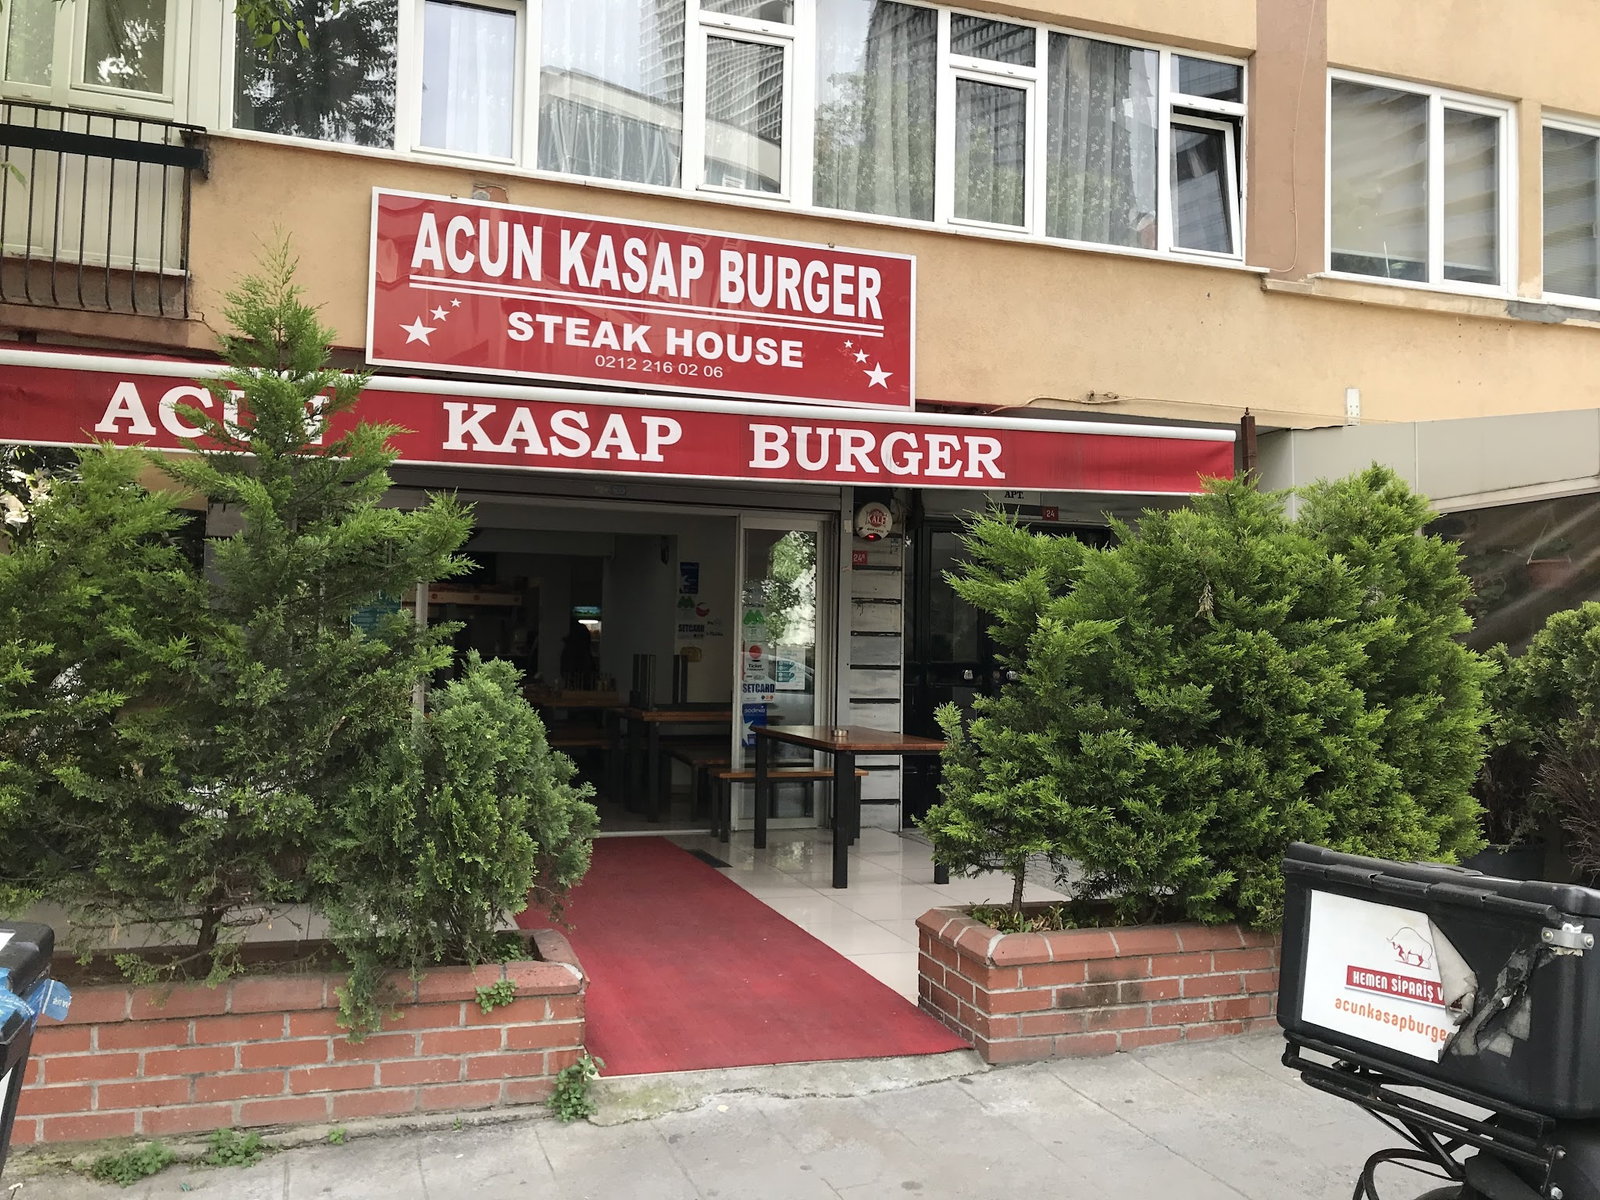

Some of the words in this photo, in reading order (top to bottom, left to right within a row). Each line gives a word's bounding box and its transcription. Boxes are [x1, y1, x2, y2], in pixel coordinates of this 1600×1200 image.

[410, 211, 543, 282] ACUN
[559, 229, 706, 299] KASAP
[719, 249, 883, 321] BURGER
[507, 311, 653, 354] STEAK
[666, 328, 805, 369] HOUSE
[594, 355, 638, 371] 0212
[642, 359, 675, 375] 216
[677, 362, 699, 377] 02
[702, 364, 724, 379] 06
[441, 401, 684, 464] KASAP
[748, 422, 1006, 480] BURGER
[1004, 490, 1025, 500] APT.
[1046, 509, 1056, 519] 24
[742, 683, 775, 693] SETCARD
[1353, 970, 1388, 990] HEMEN
[1391, 977, 1434, 1002] SİPARİŞ
